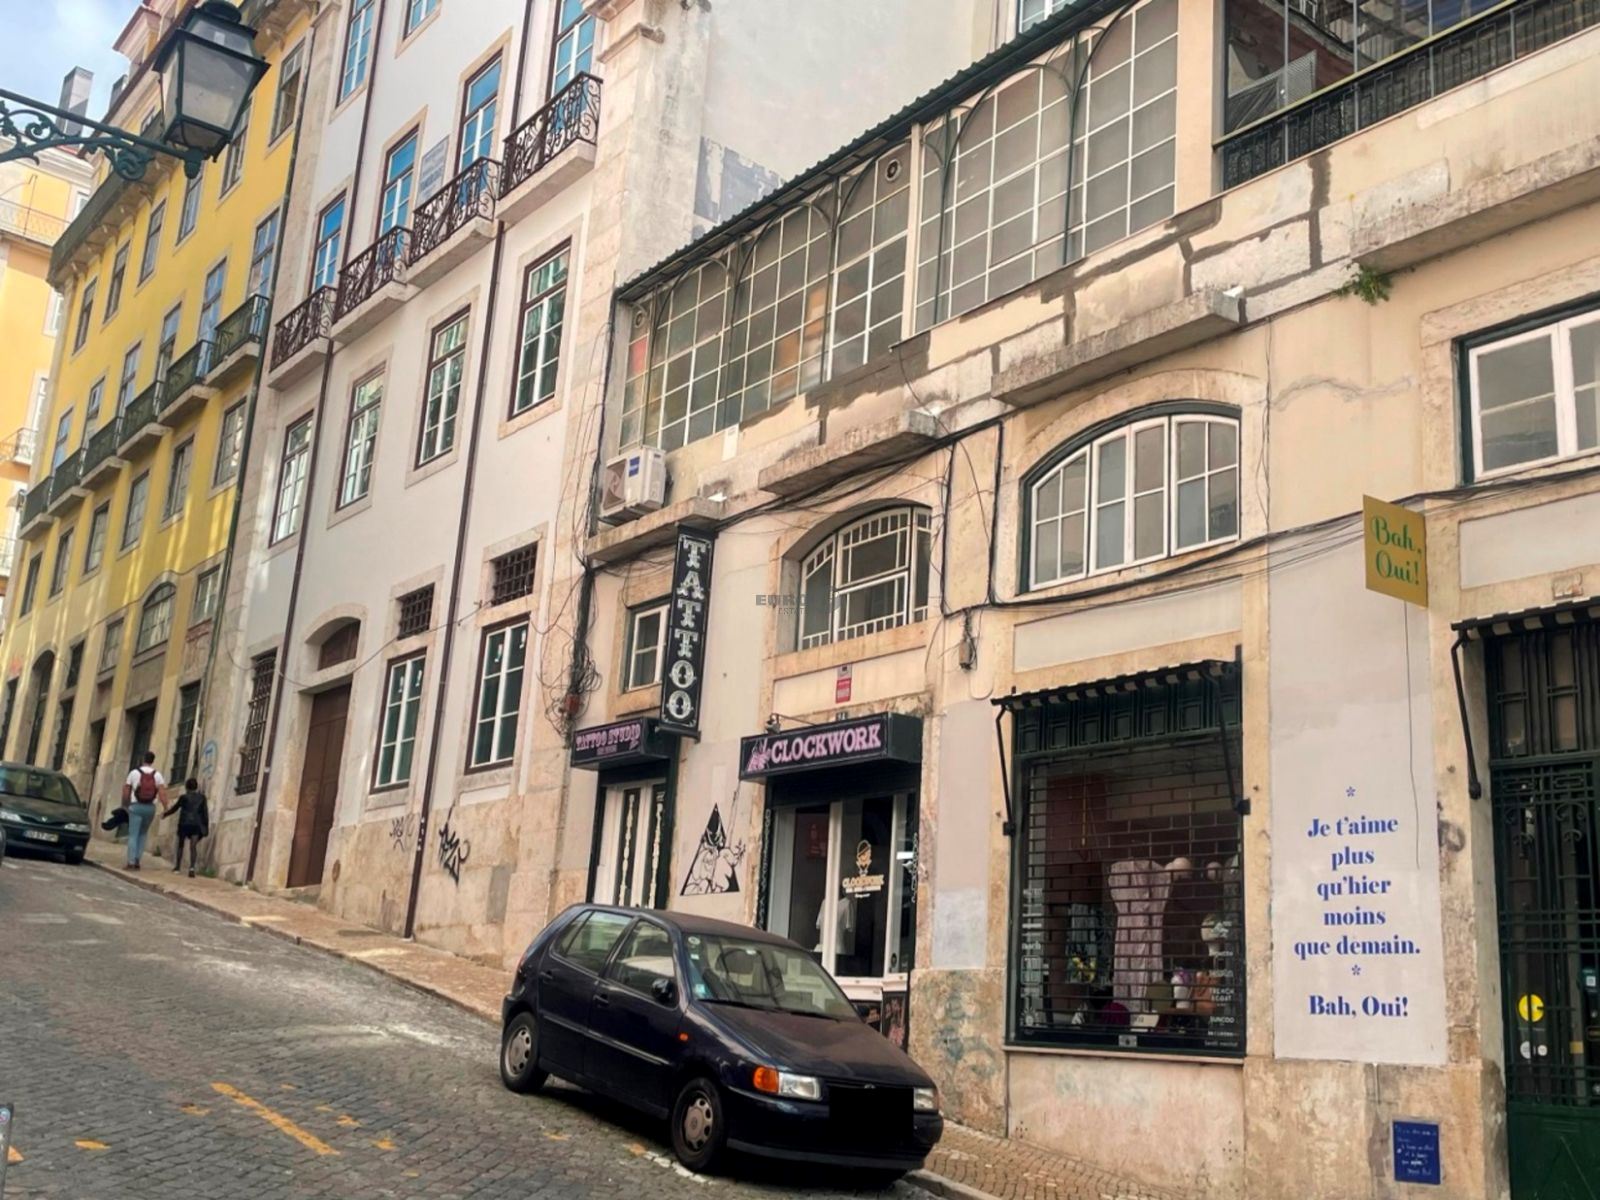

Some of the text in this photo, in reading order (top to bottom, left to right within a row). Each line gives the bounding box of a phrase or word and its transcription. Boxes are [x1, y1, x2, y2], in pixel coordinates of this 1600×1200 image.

[1375, 549, 1420, 586] Oui!
[666, 538, 707, 720] TATTOO
[575, 730, 607, 752] TATTOO
[771, 723, 882, 764] CLOCKWORK
[1307, 815, 1399, 838] Je t’aime
[1331, 846, 1375, 871] plus
[1317, 875, 1391, 901] qu’hier
[1324, 905, 1386, 926] moins
[1294, 935, 1420, 961] que demain.
[1309, 995, 1408, 1018] Bah, Oui!
